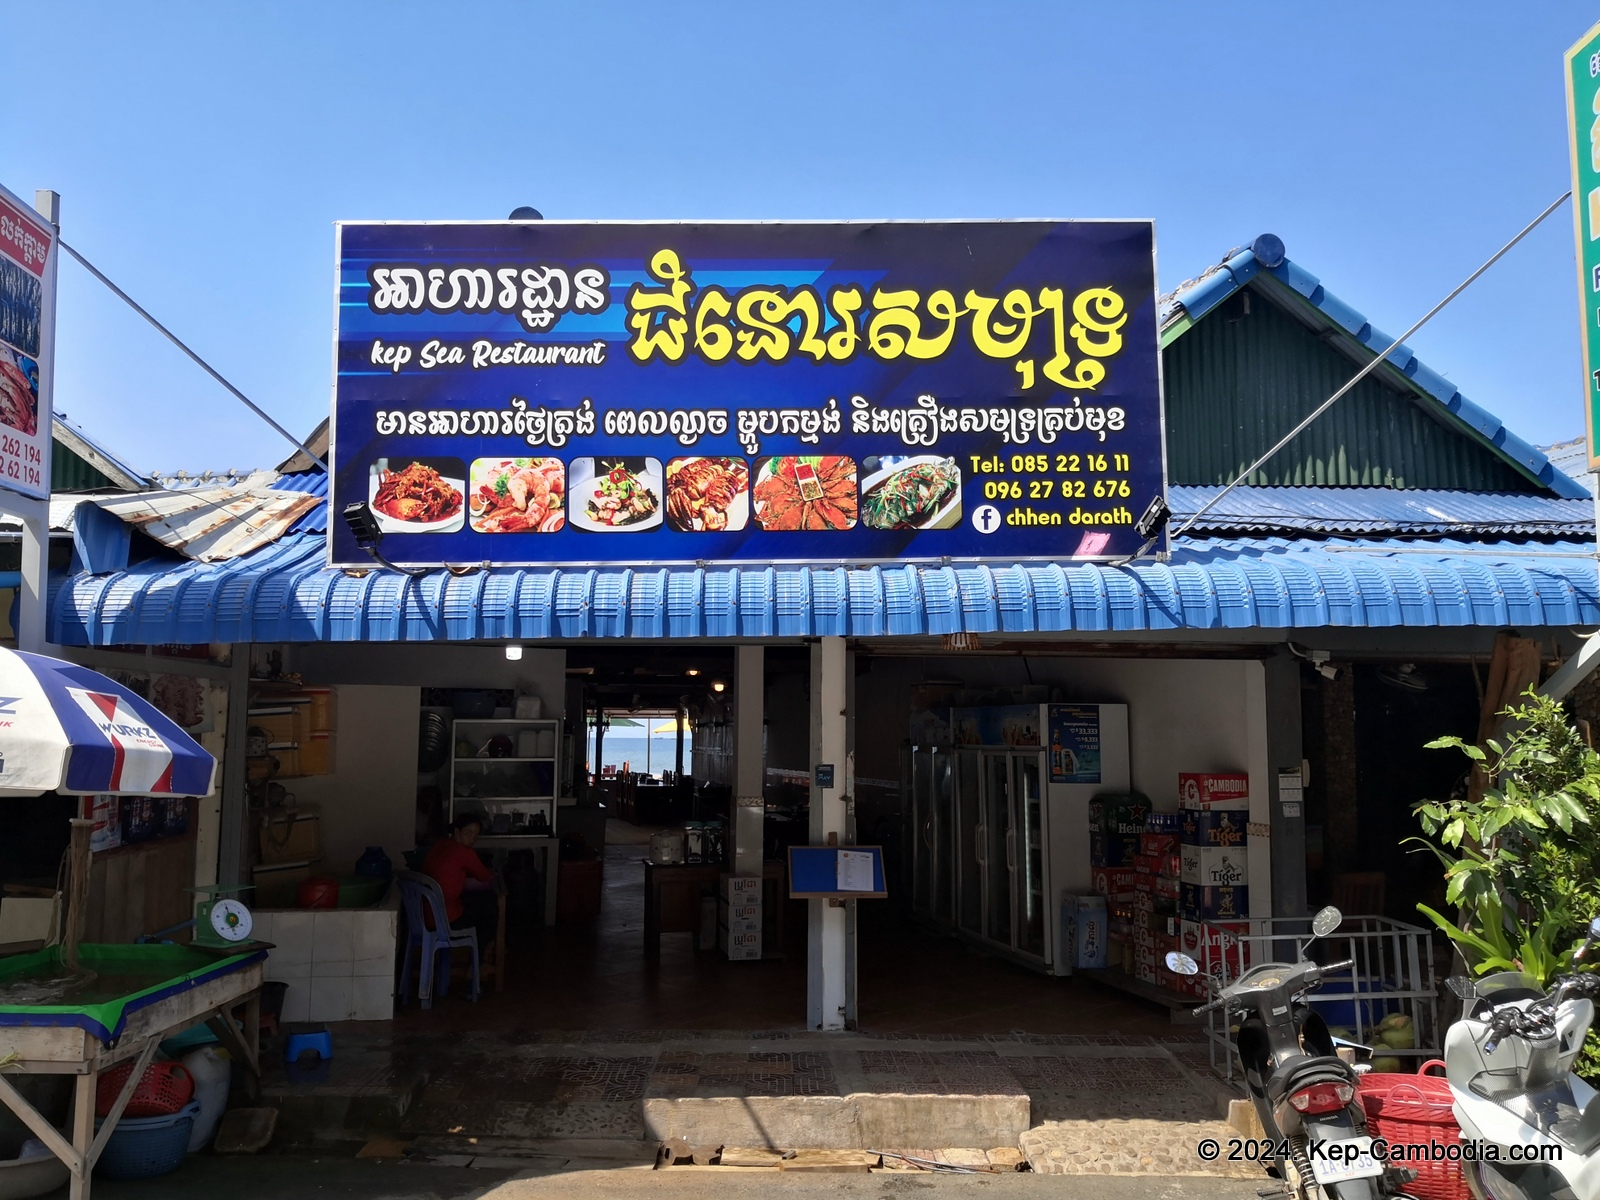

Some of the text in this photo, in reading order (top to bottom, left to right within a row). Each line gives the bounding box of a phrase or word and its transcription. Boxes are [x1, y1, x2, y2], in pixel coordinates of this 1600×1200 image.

[371, 340, 606, 372] kep Sea Restaurant
[24, 443, 41, 466] 194
[970, 454, 1130, 473] Tel: 085 22 16 11
[8, 460, 20, 480] 62
[23, 465, 41, 487] 194
[984, 480, 1131, 499] 096 27 82 676
[1006, 506, 1133, 526] chhen darath
[98, 722, 157, 740] WURKZ
[1208, 778, 1247, 793] CAMBODIA
[1208, 826, 1243, 847] Tiger
[1184, 857, 1198, 871] Tiger
[1211, 869, 1242, 886] Tiger
